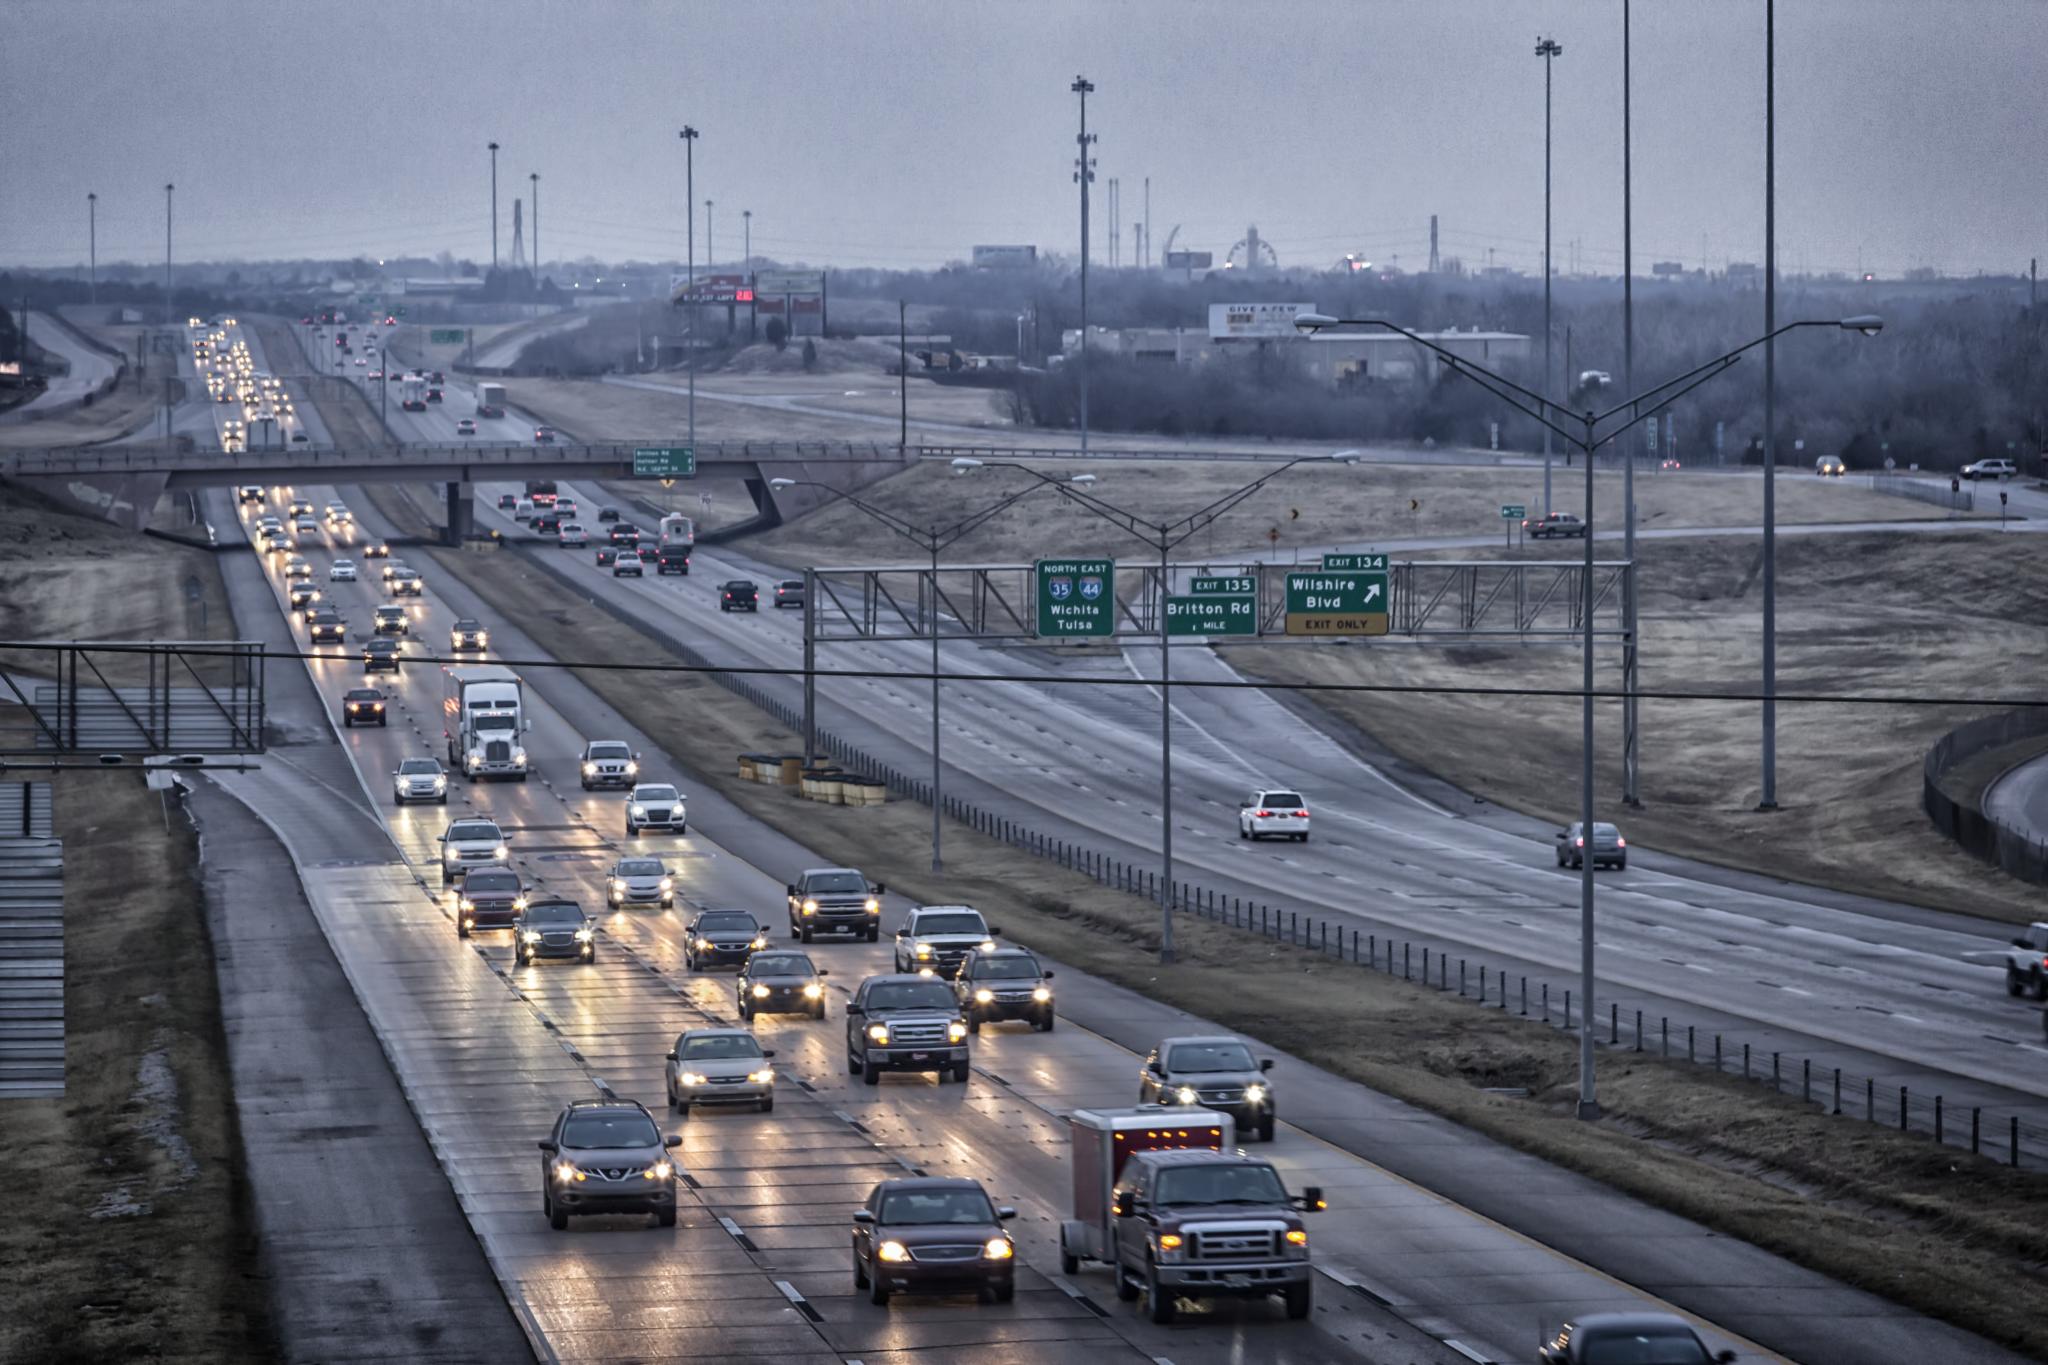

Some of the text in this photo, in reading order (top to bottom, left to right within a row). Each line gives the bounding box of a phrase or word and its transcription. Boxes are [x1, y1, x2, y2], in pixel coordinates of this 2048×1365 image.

[1328, 556, 1383, 568] EXIT 134
[1044, 564, 1106, 574] NORTH EAST
[1053, 583, 1069, 595] 35
[1083, 583, 1099, 595] 44
[1196, 579, 1250, 591] EXIT 135
[1292, 578, 1355, 590] Wilshire
[1306, 596, 1341, 608] Blvd
[1050, 604, 1099, 615] Wichita
[1167, 602, 1250, 615] Britton Rd
[1057, 619, 1093, 630] Tulsa
[1203, 621, 1226, 630] MILE
[1305, 620, 1368, 629] EXIT ONLY
